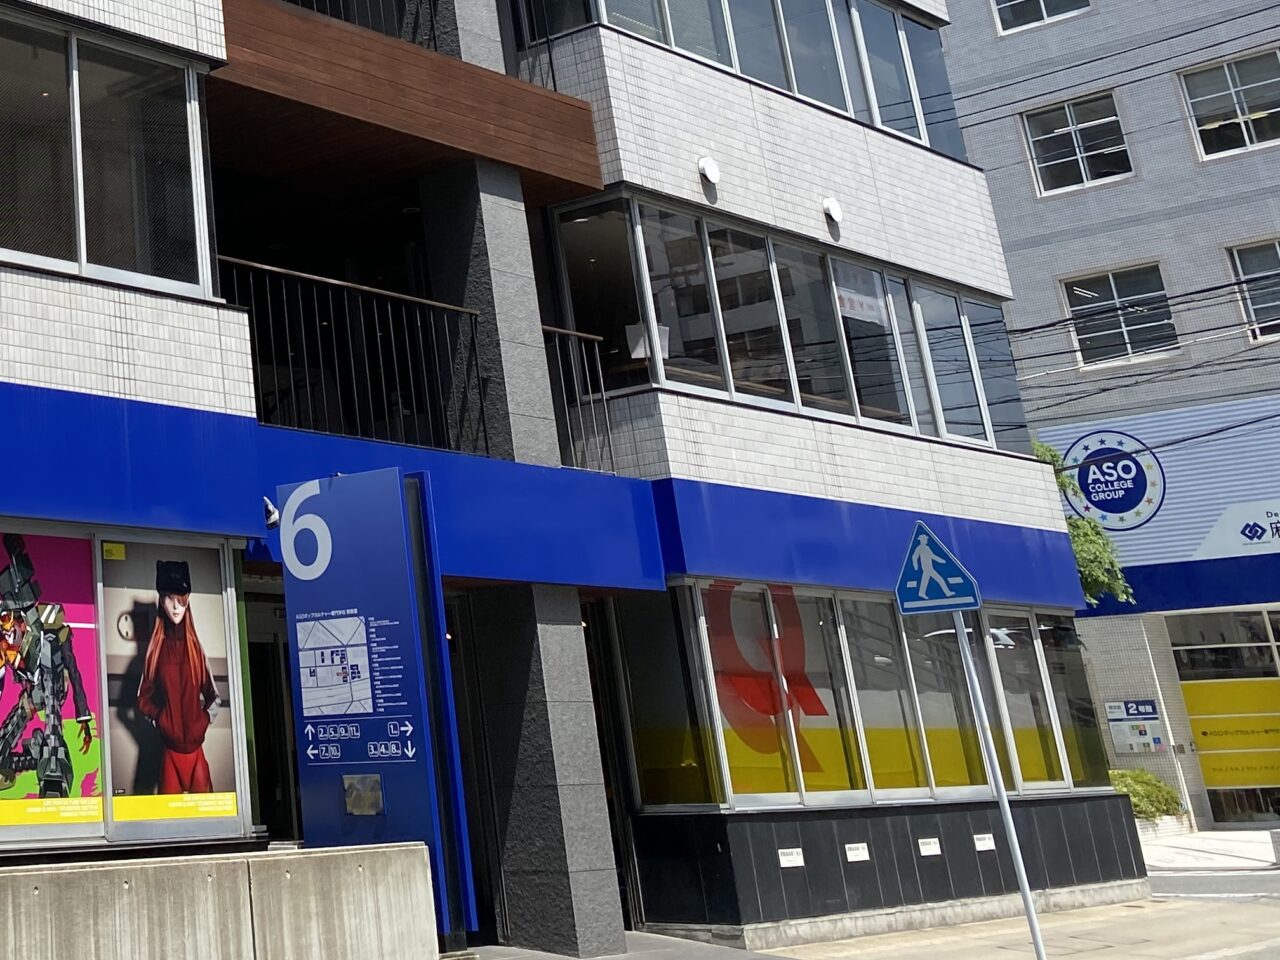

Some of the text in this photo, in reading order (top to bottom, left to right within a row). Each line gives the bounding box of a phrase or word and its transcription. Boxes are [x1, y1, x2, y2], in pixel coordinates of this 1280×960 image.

[1087, 459, 1137, 483] ASO
[1088, 479, 1134, 493] COLLEGE
[1091, 490, 1125, 501] GROUP
[280, 479, 332, 581] 6
